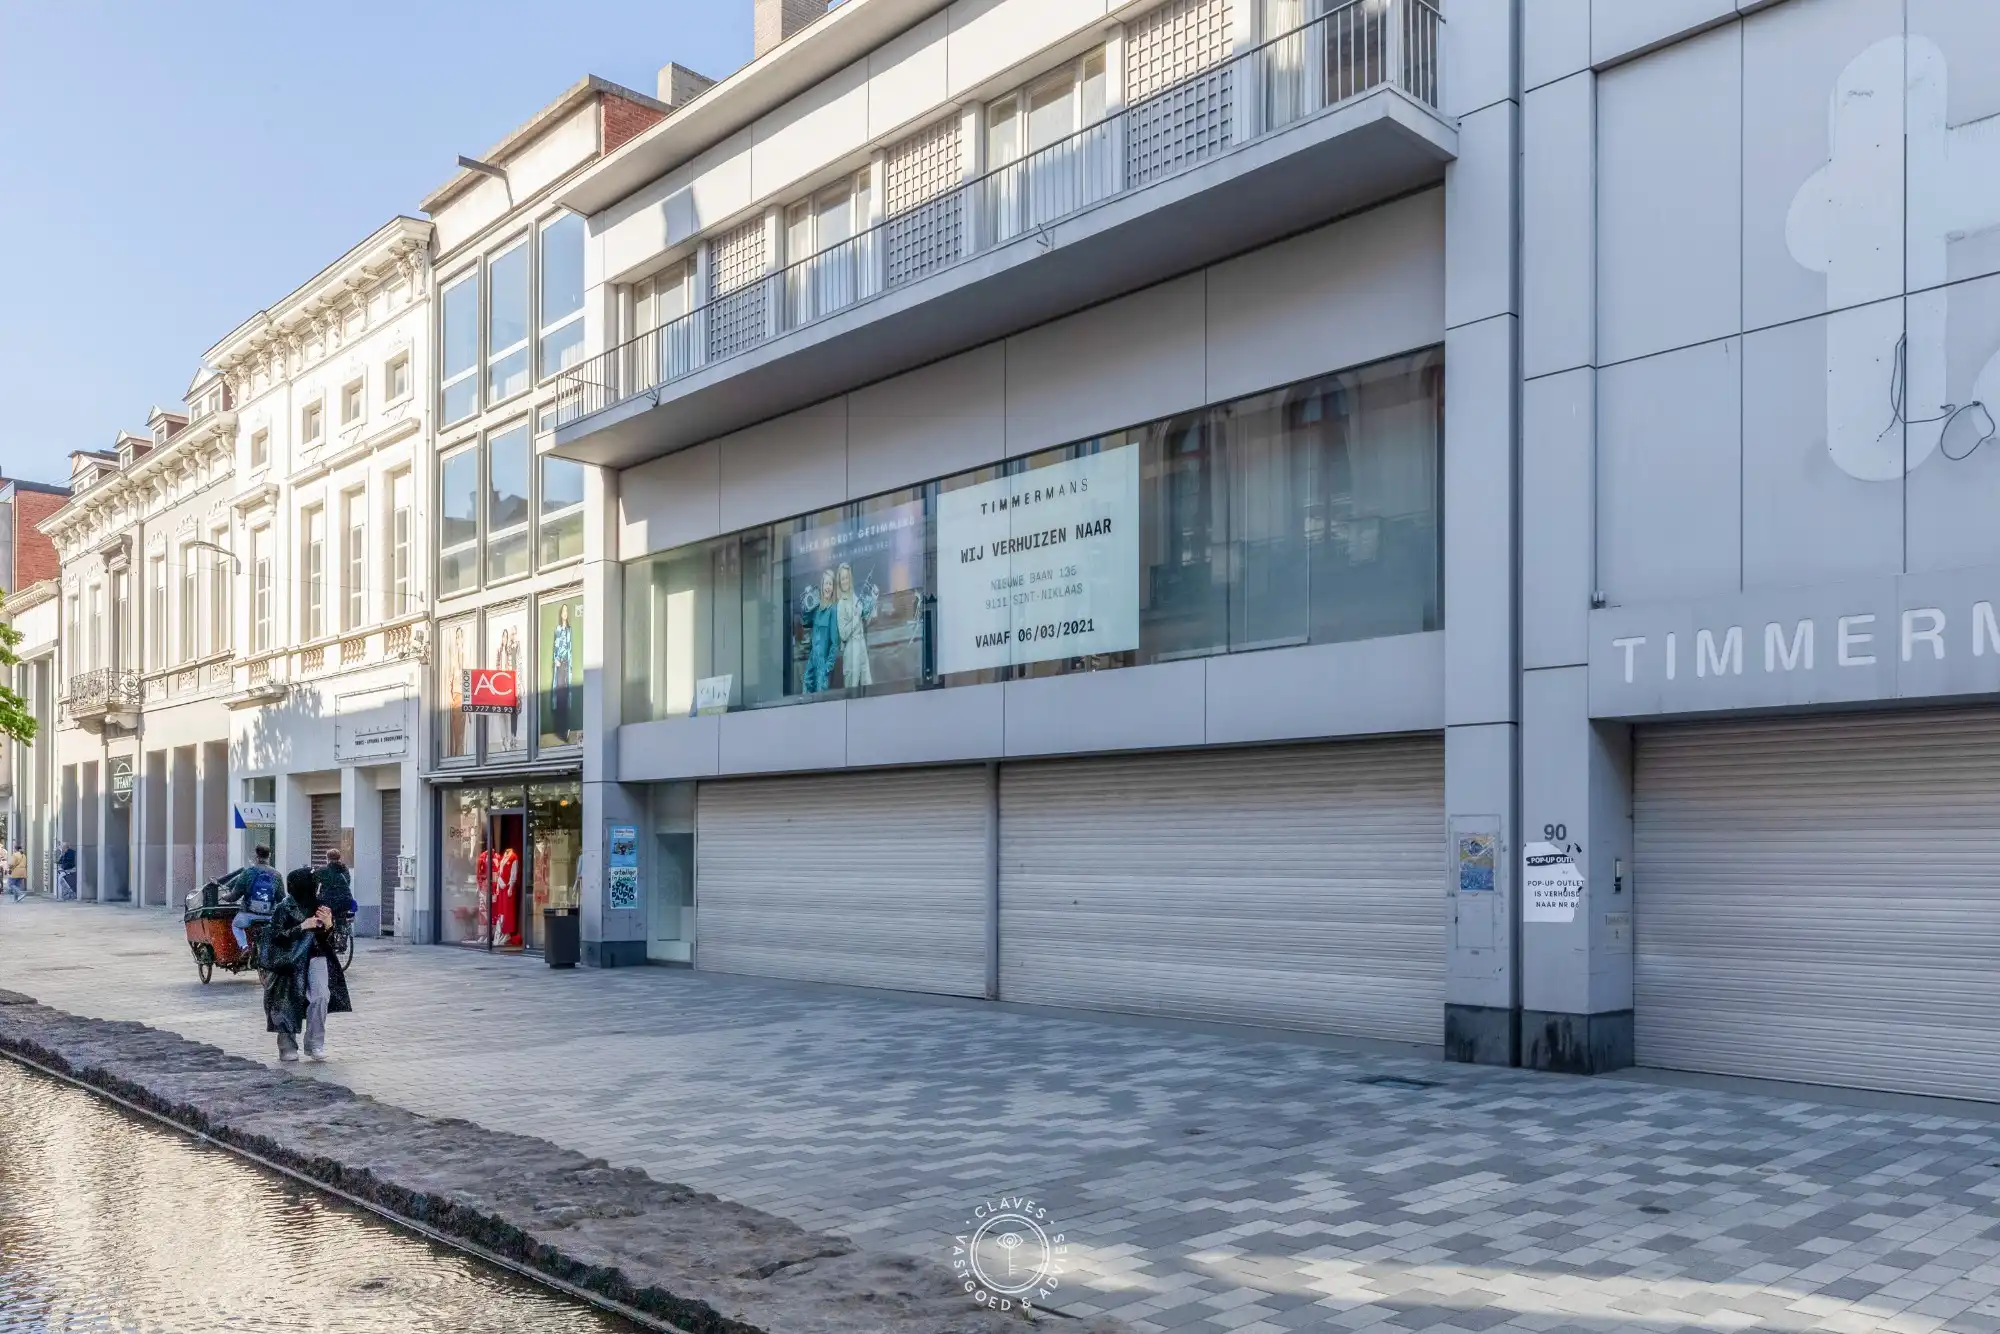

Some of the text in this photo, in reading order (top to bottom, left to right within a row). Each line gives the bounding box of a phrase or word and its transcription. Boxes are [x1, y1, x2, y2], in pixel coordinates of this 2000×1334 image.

[981, 478, 1089, 515] TIMMERMANS
[960, 518, 1112, 564] WIJ VERHUIZEN NAAR
[990, 574, 1024, 590] NIEUWE
[1029, 569, 1053, 584] BAAN
[1012, 583, 1083, 606] SINT-NIKLAAS
[975, 618, 1095, 648] VANAF 06/03/2021
[474, 671, 513, 696] AC
[463, 694, 470, 702] TE
[1543, 824, 1567, 840] 90
